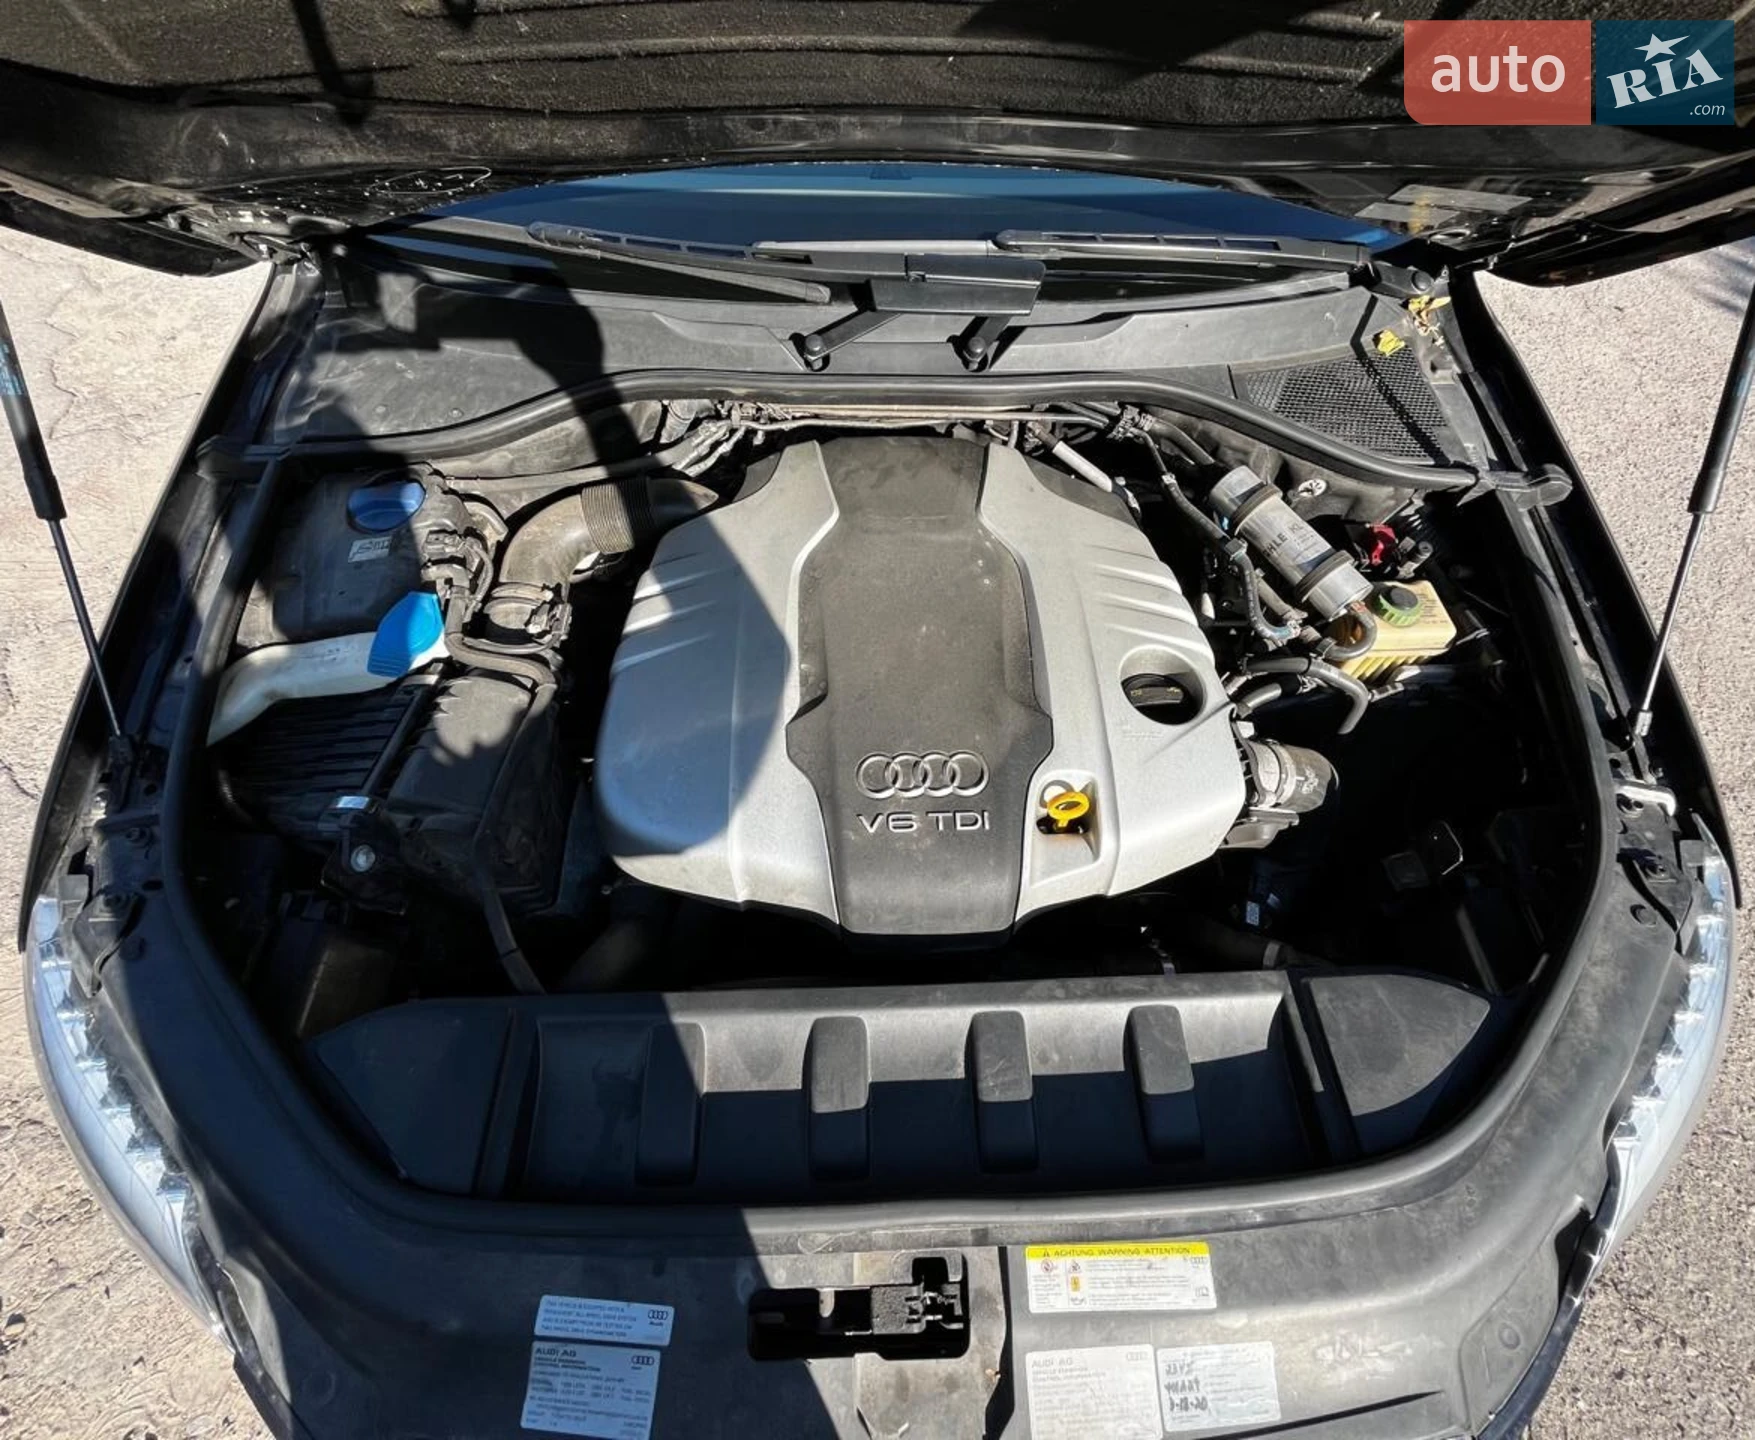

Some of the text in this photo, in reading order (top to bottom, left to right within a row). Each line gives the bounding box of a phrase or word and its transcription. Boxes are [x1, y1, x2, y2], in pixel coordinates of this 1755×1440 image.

[857, 809, 990, 833] V6 TDI
[1054, 1247, 1190, 1257] ACHTUNG WARNING ATTENTION
[535, 1347, 560, 1357] AUDI
[1031, 1358, 1055, 1369] AUDI
